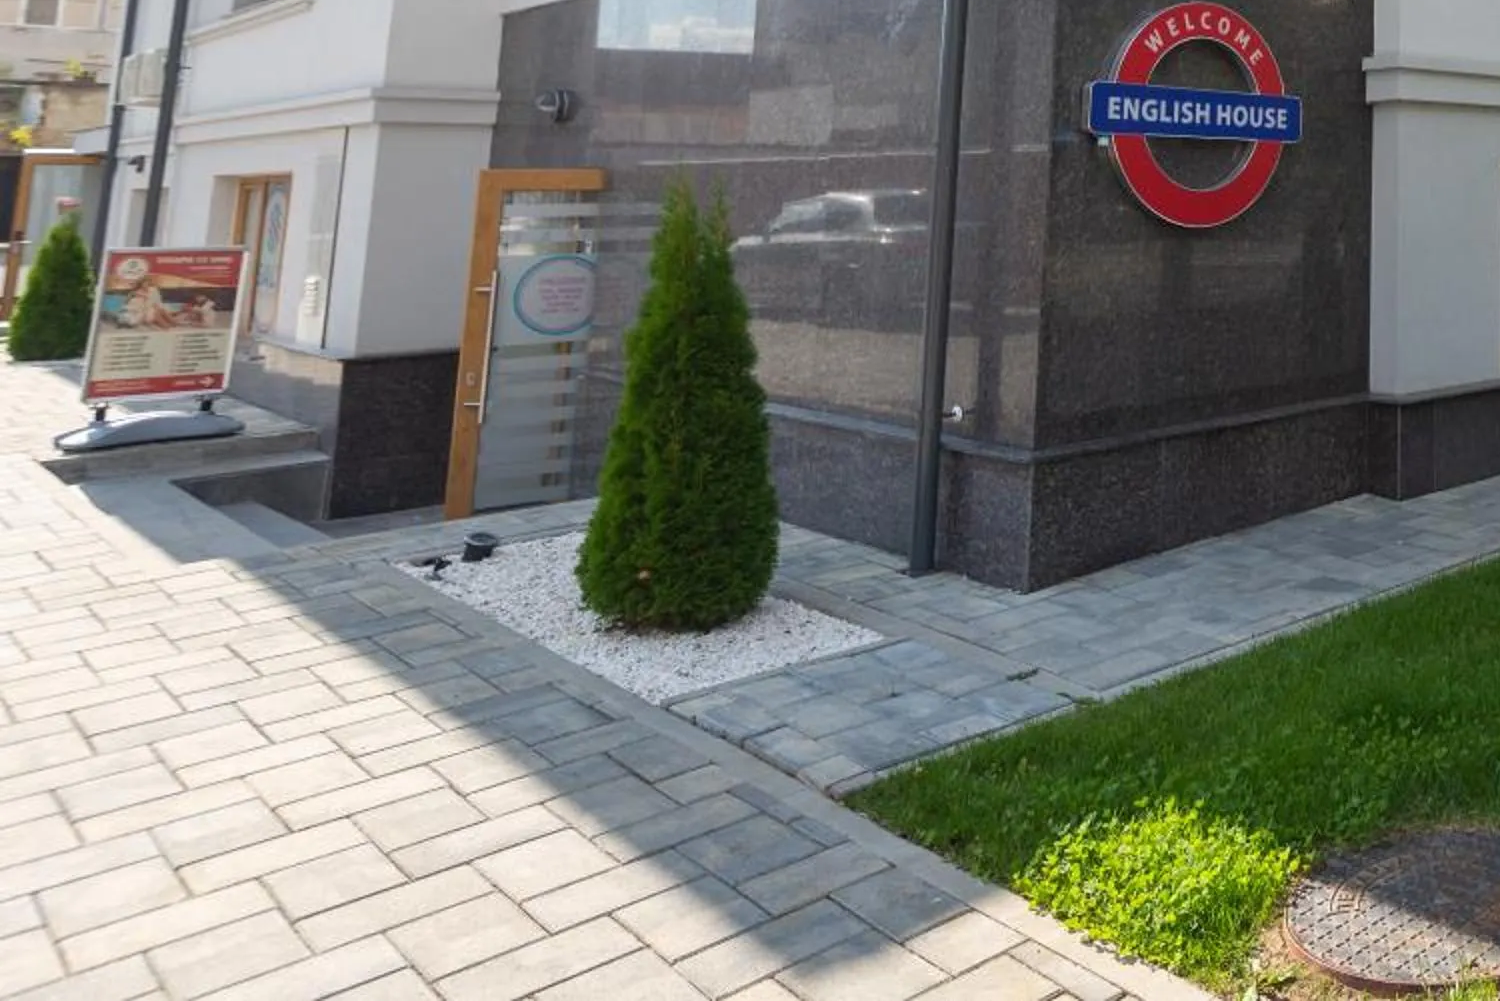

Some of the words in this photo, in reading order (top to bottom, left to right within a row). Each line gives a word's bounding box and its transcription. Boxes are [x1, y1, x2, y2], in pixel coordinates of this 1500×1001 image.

[1144, 11, 1264, 67] WELCOME
[1107, 96, 1211, 126] ENGLISH
[1216, 106, 1288, 130] HOUSE
